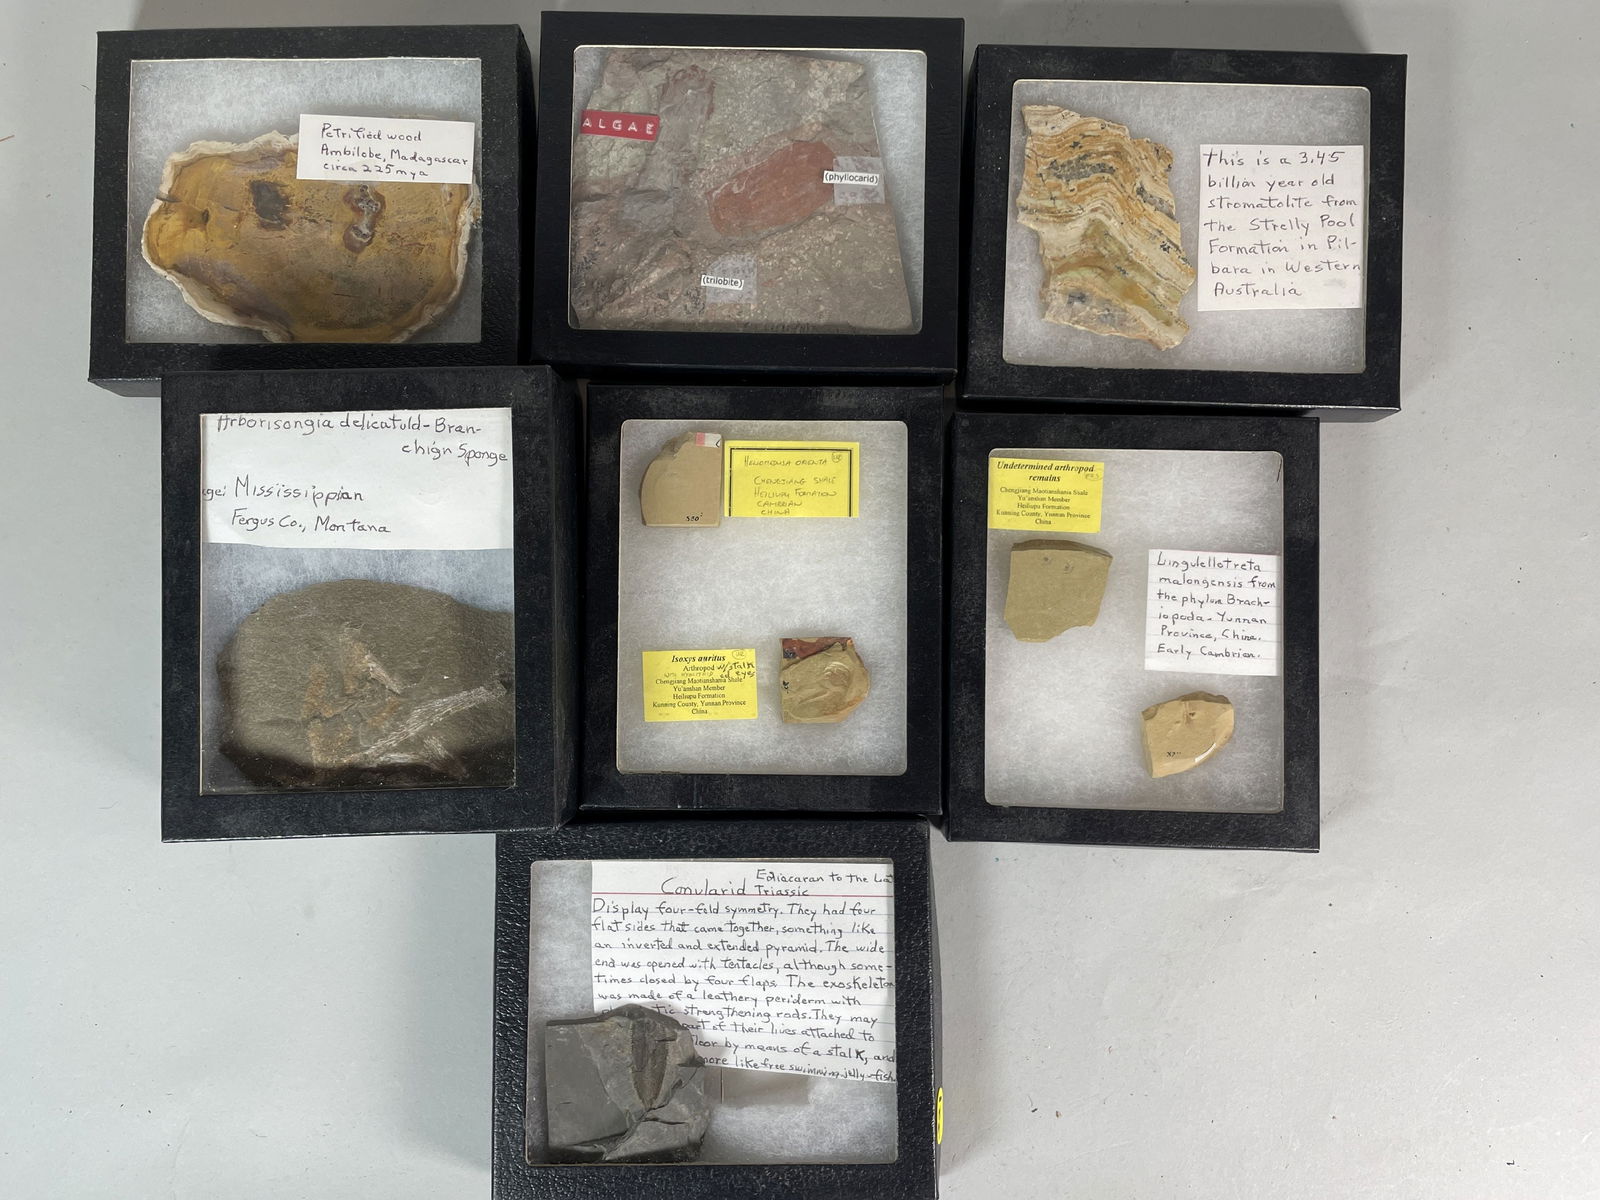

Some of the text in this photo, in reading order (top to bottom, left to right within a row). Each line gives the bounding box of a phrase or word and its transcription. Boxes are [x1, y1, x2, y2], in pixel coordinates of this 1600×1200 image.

[582, 118, 654, 135] ALGAE
[386, 131, 422, 142] wood
[320, 143, 469, 166] Ambilobe, Madagascar
[1256, 150, 1271, 166] is
[1279, 156, 1292, 165] a
[1298, 150, 1346, 165] 3.45
[323, 159, 357, 173] circa
[1208, 173, 1335, 192] billion year old
[1207, 194, 1359, 209] stromatolite from
[1203, 213, 1356, 236] the Strelly Pool
[1209, 235, 1357, 255] Formation in Pil-
[1211, 259, 1361, 275] bara in Western
[702, 275, 743, 288] (trilobite)
[1214, 281, 1302, 298] Australia
[457, 443, 508, 467] Sponge
[997, 461, 1095, 474] Undetermined arthropod
[1028, 474, 1061, 482] remains
[234, 474, 364, 507] Mississippian
[231, 507, 275, 532] Fergus
[314, 515, 391, 534] Montana
[1034, 518, 1052, 526] China
[1159, 573, 1276, 589] malongensis from
[1157, 588, 1177, 600] the
[1227, 594, 1270, 607] Brach-
[1216, 611, 1267, 624] Yunnan
[1160, 624, 1217, 641] Province,
[671, 655, 696, 664] Isoxys
[697, 654, 726, 663] auritus
[1157, 643, 1261, 660] Early Cambrian.
[683, 665, 715, 673] Arthropod
[756, 869, 824, 884] Ediacaran
[829, 872, 843, 882] to
[661, 876, 746, 896] Conularid
[754, 885, 809, 897] Triassic
[593, 898, 876, 922] Display four-fold symmetry. They had four
[592, 917, 876, 940] flat sides that came together, something like
[594, 938, 885, 958] an inverted and extended pyramid. The wide
[595, 957, 893, 976] end was opened with tentacles, although some-
[594, 973, 633, 984] times
[640, 974, 676, 985] closed
[684, 975, 700, 992] by
[704, 975, 734, 986] four
[786, 974, 816, 988] The
[598, 992, 622, 1000] was
[628, 990, 662, 1001] made
[668, 990, 683, 1001] of
[703, 989, 758, 1007] leathery
[765, 994, 826, 1007] periderm
[831, 995, 862, 1006] with
[684, 1004, 771, 1023] strengthening
[811, 1008, 842, 1025] They
[850, 1016, 878, 1029] may
[712, 1020, 727, 1032] of
[730, 1022, 764, 1033] their
[771, 1022, 796, 1036] lives
[801, 1027, 856, 1040] attached
[858, 1030, 875, 1042] to
[725, 1037, 739, 1054] by
[744, 1044, 788, 1054] means
[793, 1041, 812, 1056] of
[827, 1044, 868, 1065] stalk,
[873, 1049, 896, 1063] and
[735, 1055, 761, 1069] like
[760, 1058, 785, 1071] free
